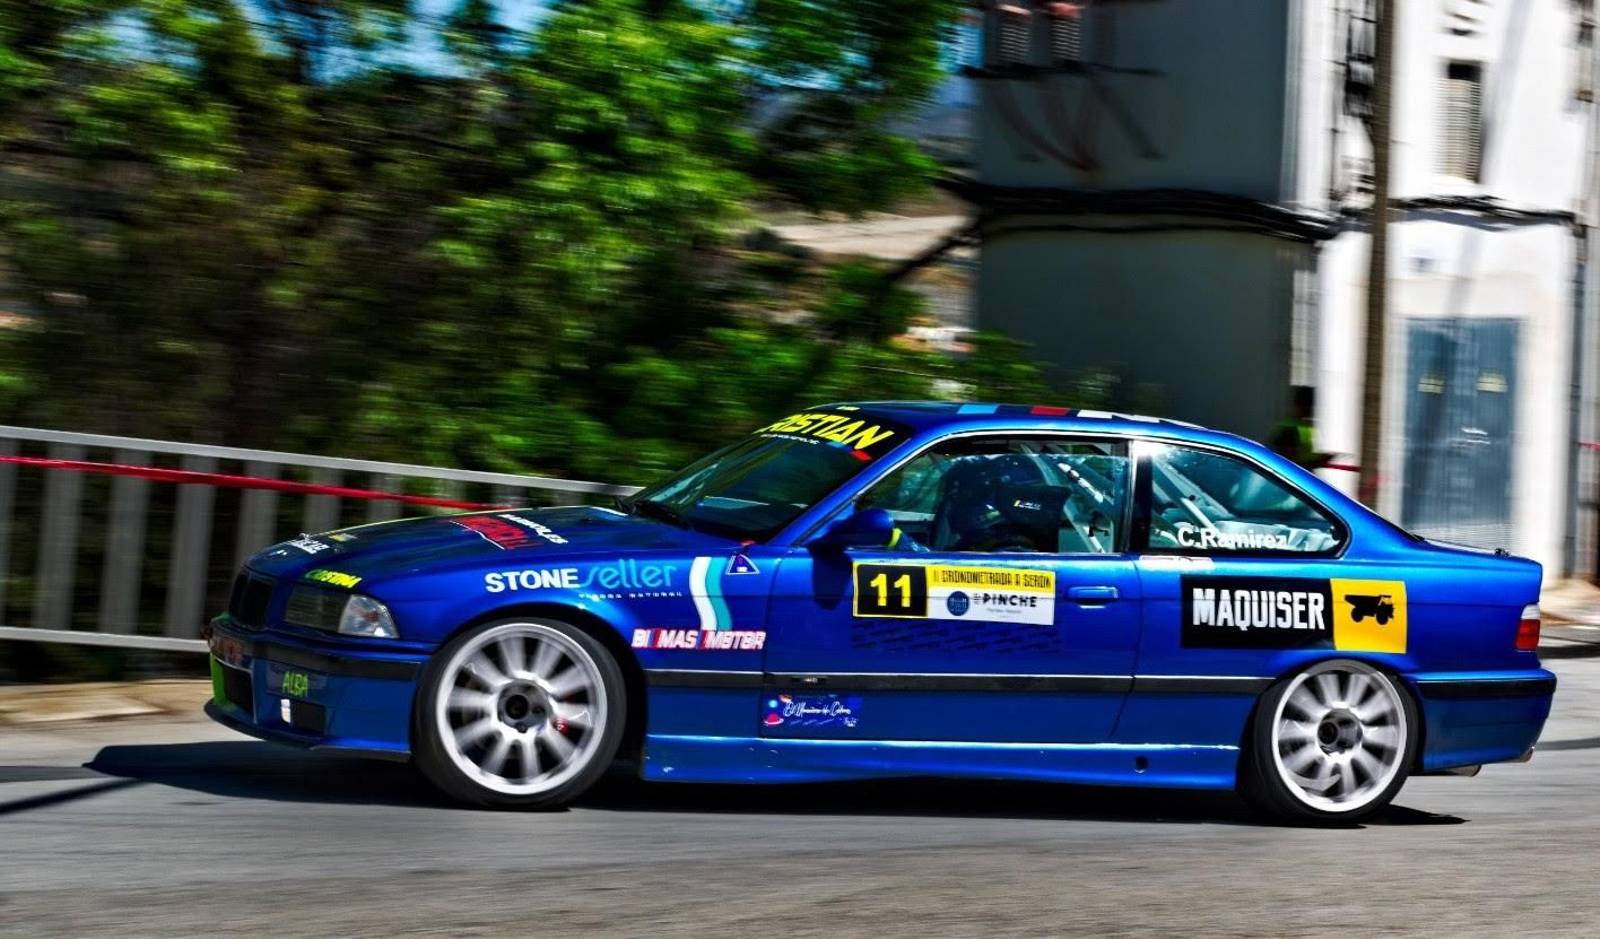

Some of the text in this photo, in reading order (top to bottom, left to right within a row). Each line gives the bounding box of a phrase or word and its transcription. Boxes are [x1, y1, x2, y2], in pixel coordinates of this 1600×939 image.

[870, 573, 911, 608] 11
[983, 592, 1037, 608] PINCHE
[1192, 587, 1325, 631] MAQUISER
